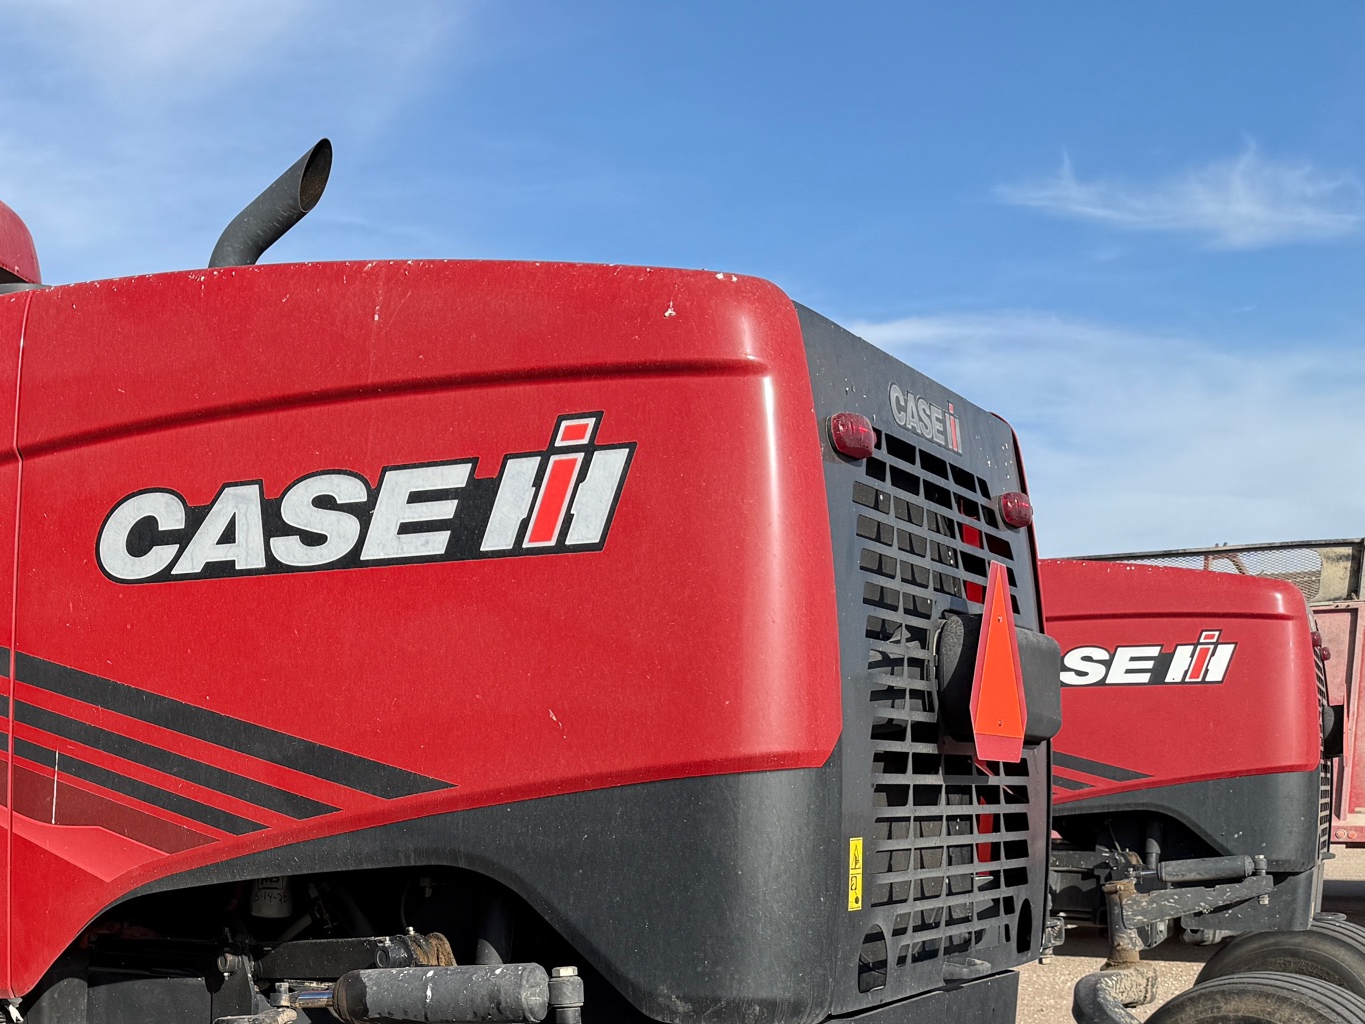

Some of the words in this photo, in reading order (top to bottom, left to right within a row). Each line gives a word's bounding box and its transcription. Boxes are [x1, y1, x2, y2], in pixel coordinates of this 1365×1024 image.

[889, 383, 945, 446] CASE
[98, 464, 472, 580] CASE
[479, 416, 630, 552] IH
[1060, 645, 1162, 685] SE
[1164, 630, 1236, 683] IH
